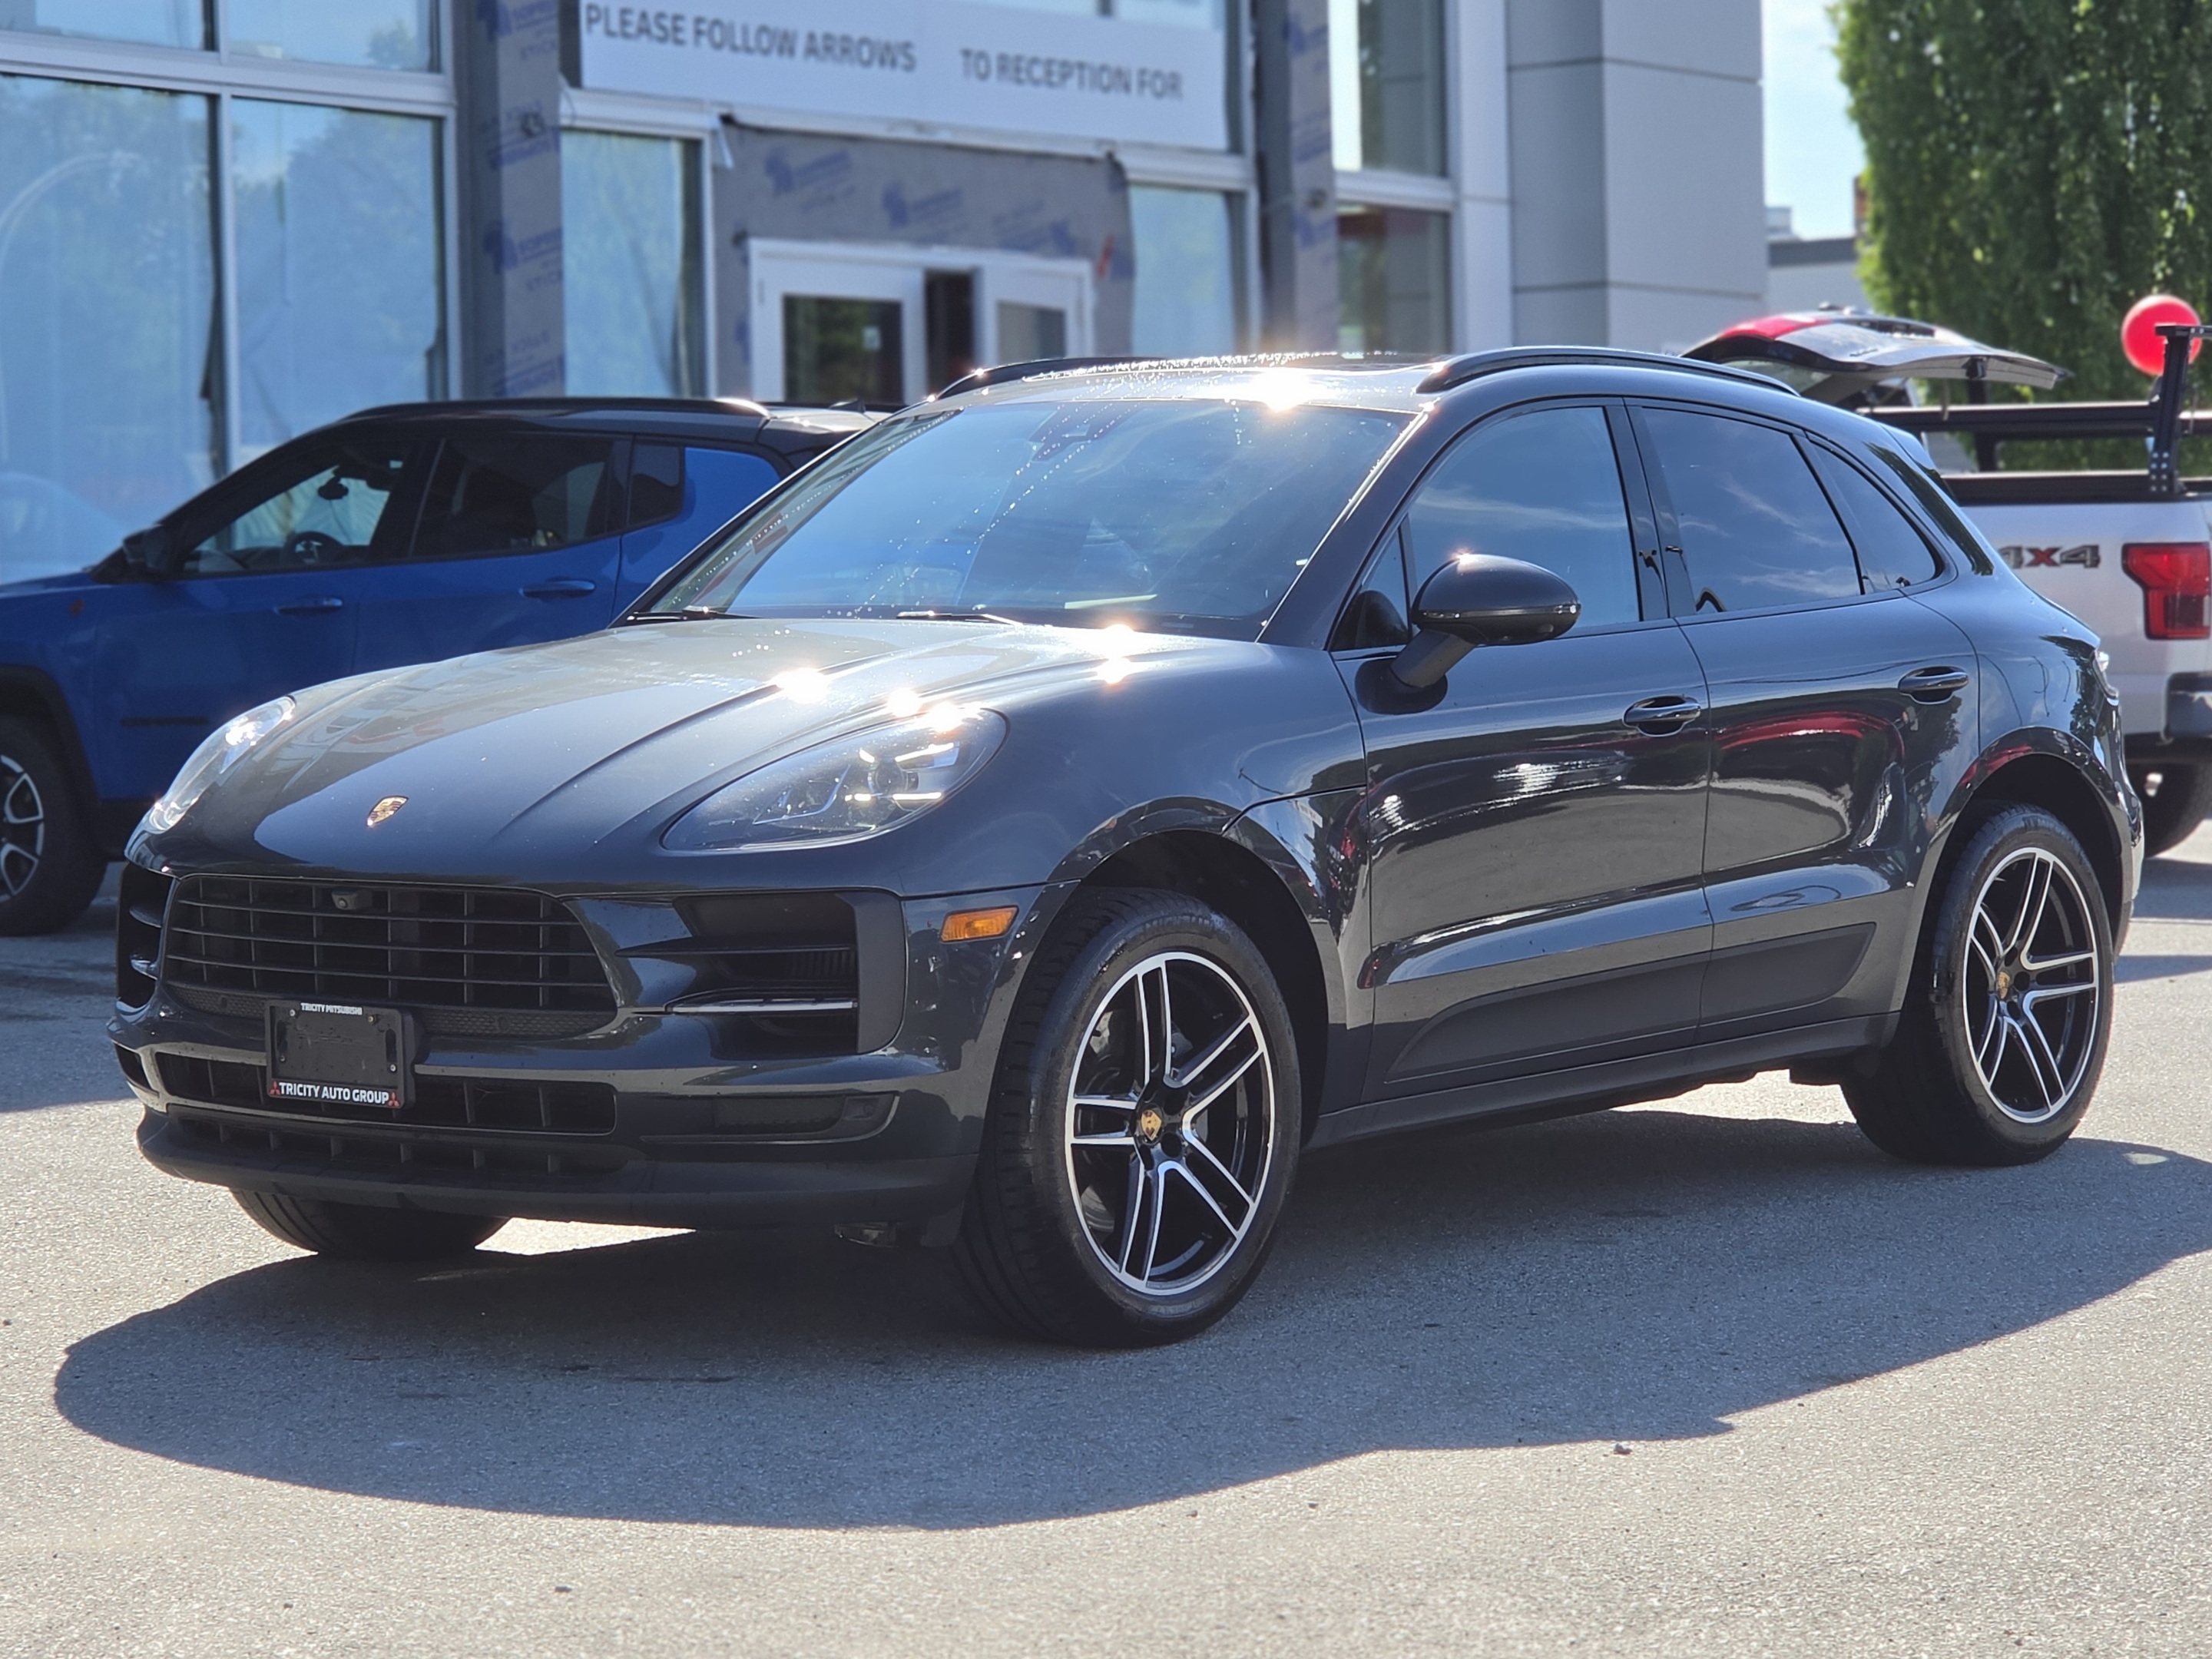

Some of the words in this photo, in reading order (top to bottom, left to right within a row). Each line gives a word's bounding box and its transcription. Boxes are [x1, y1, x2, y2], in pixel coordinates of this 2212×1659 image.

[585, 3, 686, 46] PLEASE
[693, 16, 800, 58] FOLLOW
[803, 30, 917, 72] ARROWS
[960, 48, 991, 82] TO
[996, 51, 1131, 94] RECEPTION
[1136, 67, 1184, 101] FOR
[300, 1002, 325, 1014] TRICITY
[279, 1082, 320, 1098] TRICITY
[322, 1087, 349, 1101] AUTO
[353, 1089, 389, 1104] GROUP
